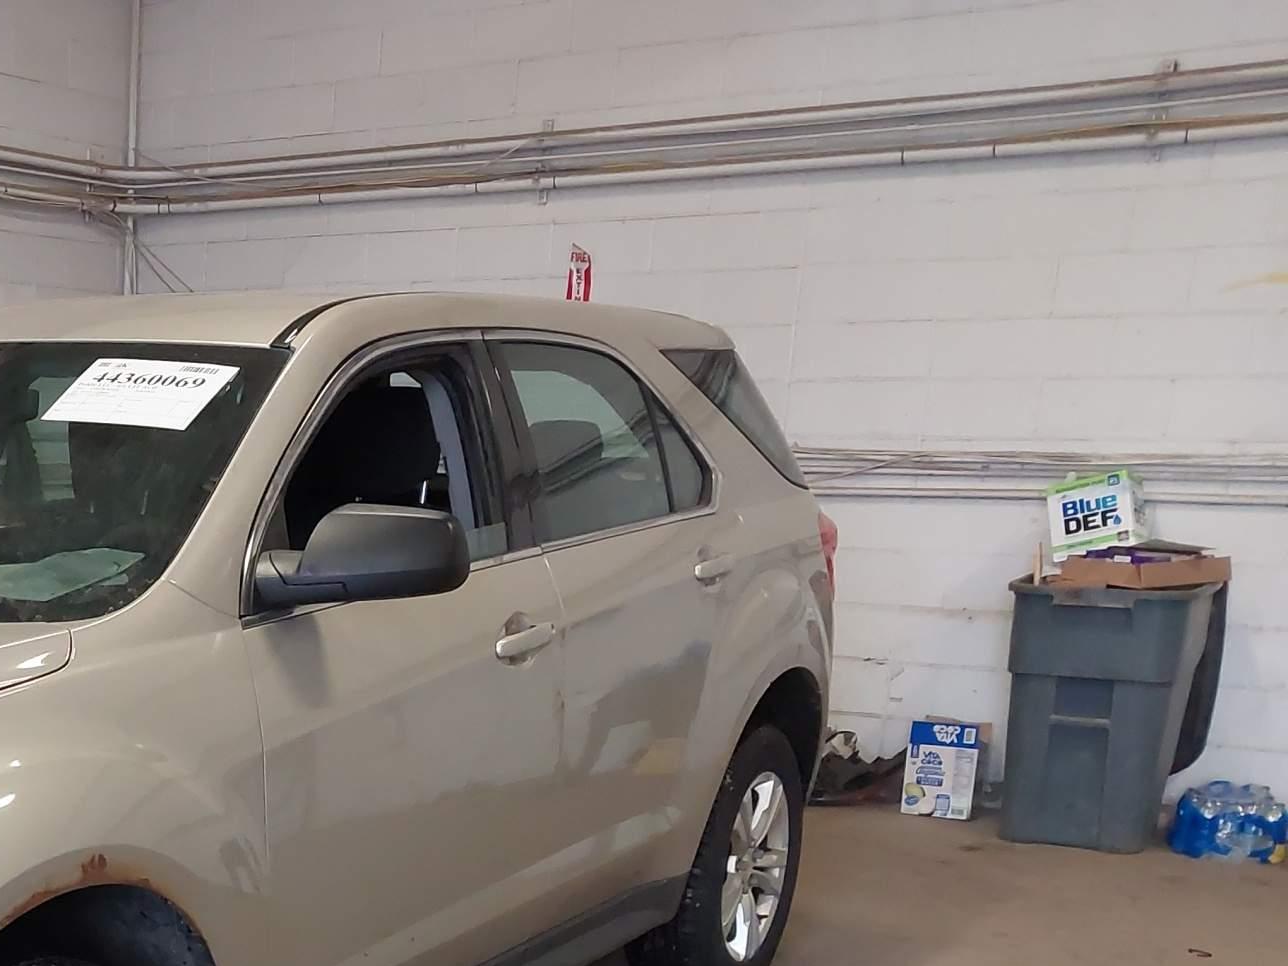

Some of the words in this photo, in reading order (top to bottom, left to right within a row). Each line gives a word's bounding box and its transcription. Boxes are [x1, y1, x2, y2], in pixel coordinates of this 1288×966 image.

[570, 252, 588, 263] FIRE
[92, 371, 207, 389] 44360069
[1062, 494, 1117, 518] Blue
[1063, 508, 1119, 536] DEF
